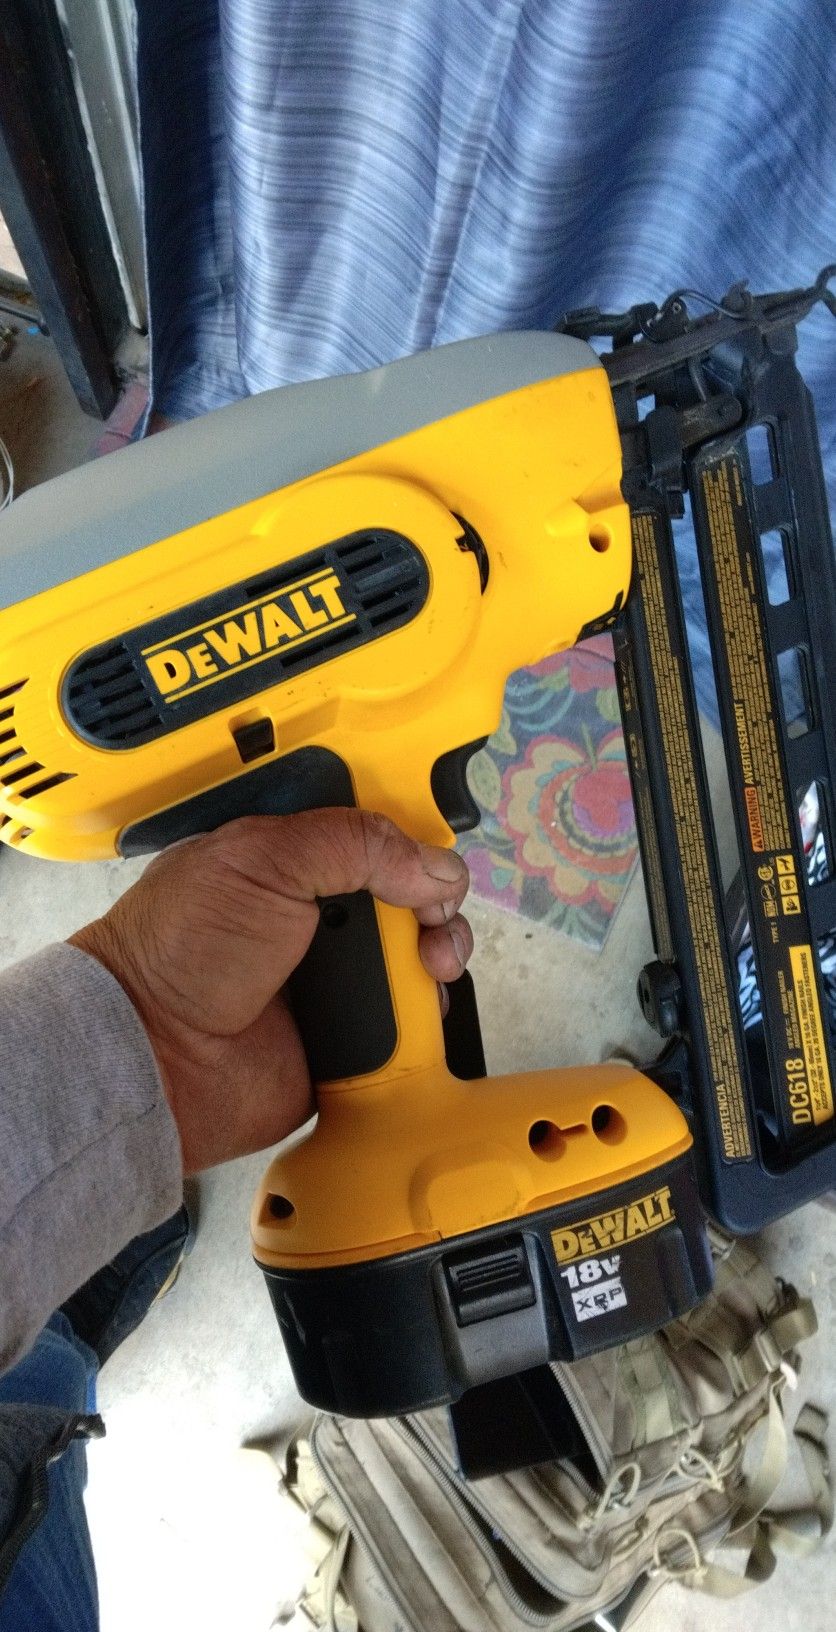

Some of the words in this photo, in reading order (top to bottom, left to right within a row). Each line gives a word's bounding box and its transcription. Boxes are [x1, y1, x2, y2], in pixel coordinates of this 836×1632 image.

[733, 701, 754, 785] AVERTISSEMENT
[747, 788, 760, 838] WARNING
[717, 1084, 734, 1158] ADVERTENCIA
[784, 1057, 812, 1124] DC618
[577, 1288, 622, 1312] XRP
